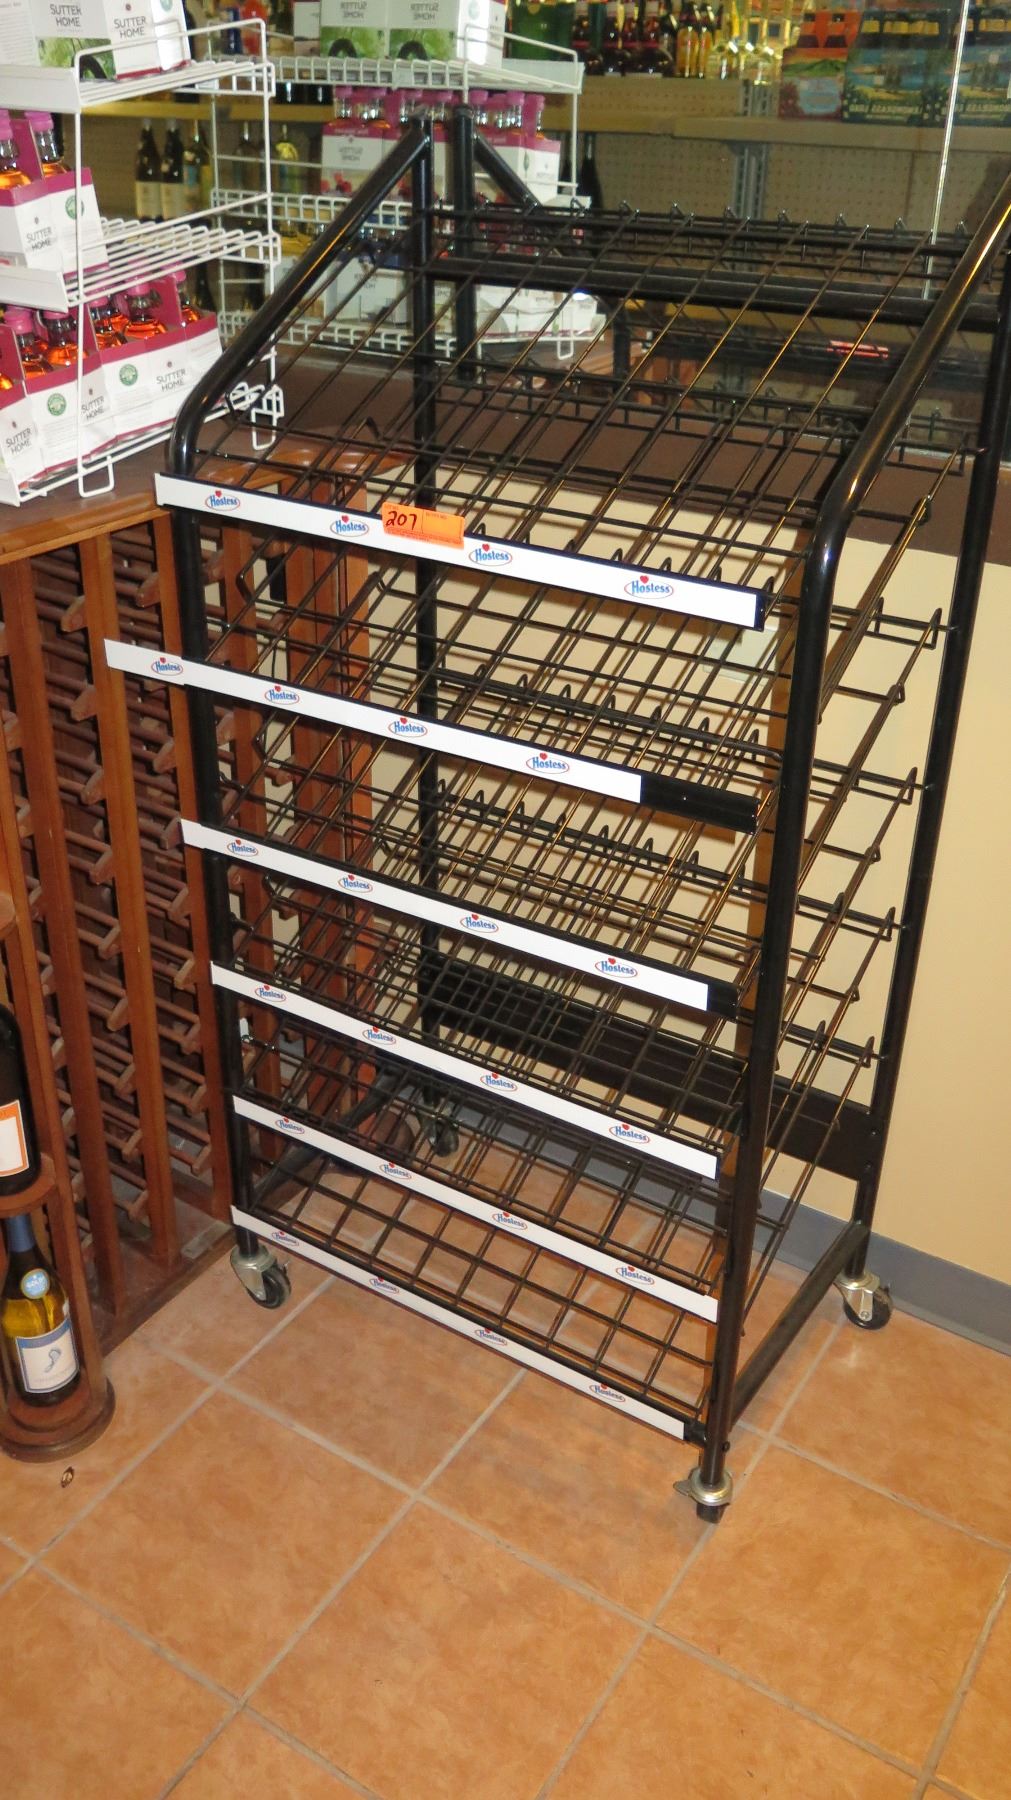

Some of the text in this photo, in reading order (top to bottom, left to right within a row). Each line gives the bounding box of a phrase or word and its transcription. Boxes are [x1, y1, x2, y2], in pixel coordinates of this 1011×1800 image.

[50, 4, 82, 17] SUTTER
[55, 17, 81, 27] HOME
[114, 16, 147, 29] SUTTER
[119, 26, 146, 39] HOME
[26, 227, 52, 243] SUTTER
[32, 239, 52, 251] HOME
[156, 368, 186, 385] SUTTER
[161, 378, 185, 392] HOME
[81, 396, 104, 414] SUTTER
[86, 406, 105, 420] HOME
[5, 428, 31, 448] SUTTER
[11, 439, 32, 454] HOME
[210, 495, 238, 507] Hostess
[335, 521, 366, 532] Hostess
[385, 510, 418, 531] 207
[475, 548, 509, 562] Hostess
[631, 580, 670, 595] Hostess
[155, 662, 181, 672] Hostess
[269, 690, 297, 701] Hostess
[393, 723, 425, 734] Hostess
[532, 757, 567, 770] Hostess
[231, 843, 256, 854] Hostess
[343, 877, 370, 889] Hostess
[465, 917, 496, 930] Hostess
[601, 961, 635, 975] Hostess
[259, 988, 284, 1000] Hostess
[367, 1029, 394, 1042] Hostess
[486, 1075, 514, 1089] Hostess
[279, 1119, 302, 1132] Hostess
[615, 1125, 647, 1141] Hostess
[383, 1164, 409, 1177] Hostess
[497, 1213, 525, 1228] Hostess
[621, 1268, 652, 1284] Hostess
